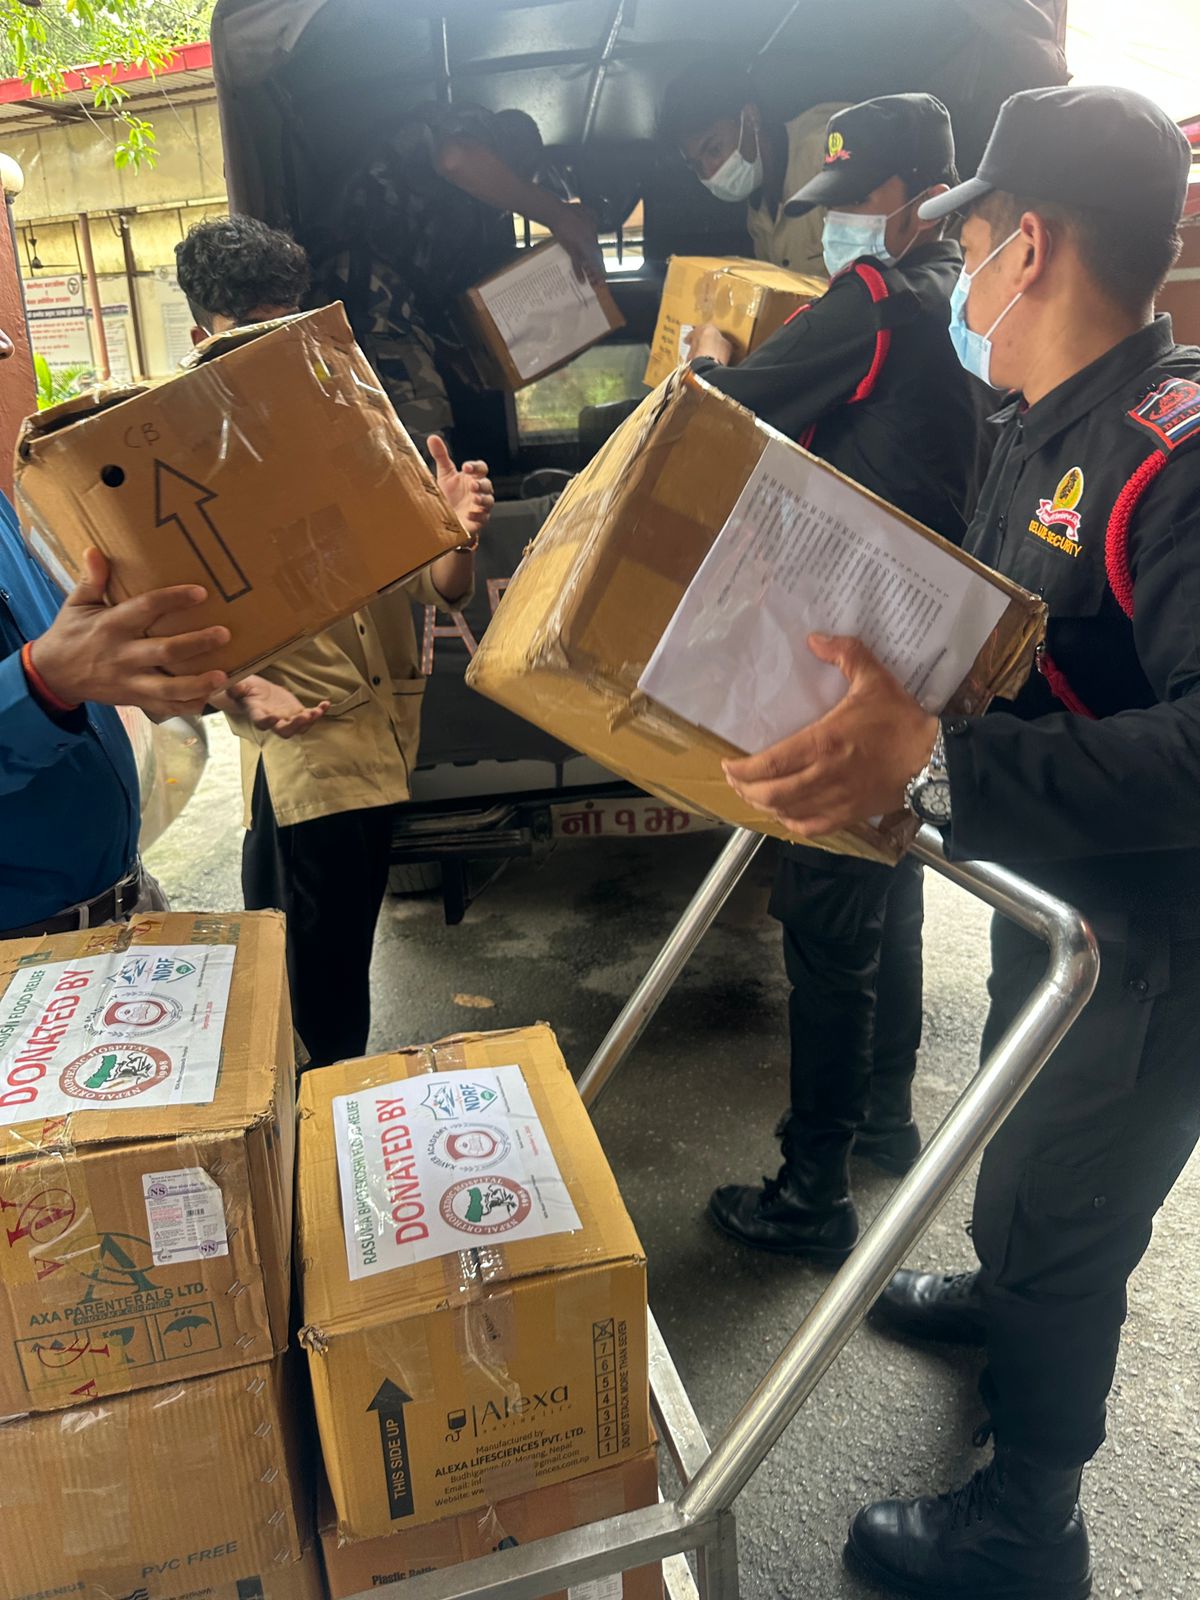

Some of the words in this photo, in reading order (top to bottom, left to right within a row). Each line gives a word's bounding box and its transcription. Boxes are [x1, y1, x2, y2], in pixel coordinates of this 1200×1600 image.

[152, 957, 175, 981] NDRF
[9, 994, 33, 1021] FLOOD
[23, 970, 46, 994] RELIEF
[0, 995, 80, 1107] DONATED
[55, 969, 94, 992] BY
[375, 1097, 407, 1124] BY
[460, 1083, 480, 1111] NDRF
[380, 1124, 430, 1246] DONATED
[29, 1313, 62, 1327] AXA
[64, 1288, 174, 1320] PARENTERALS
[178, 1282, 208, 1298] LTD.
[481, 1385, 569, 1425] Alexa
[386, 1418, 400, 1438] UP
[476, 1431, 532, 1454] Manufactured
[533, 1428, 545, 1442] by
[388, 1438, 404, 1468] SIDE
[434, 1461, 468, 1478] ALEXA
[470, 1440, 540, 1466] LIFESCIENCES
[541, 1433, 563, 1448] PVT.
[565, 1426, 587, 1440] LTD.
[549, 1441, 573, 1455] Nepal
[392, 1471, 407, 1501] THIS
[434, 1490, 470, 1507] Website:
[444, 1479, 470, 1495] Email:
[141, 1557, 180, 1579] PVC
[187, 1540, 239, 1566] FREE
[372, 1571, 407, 1586] Plastic
